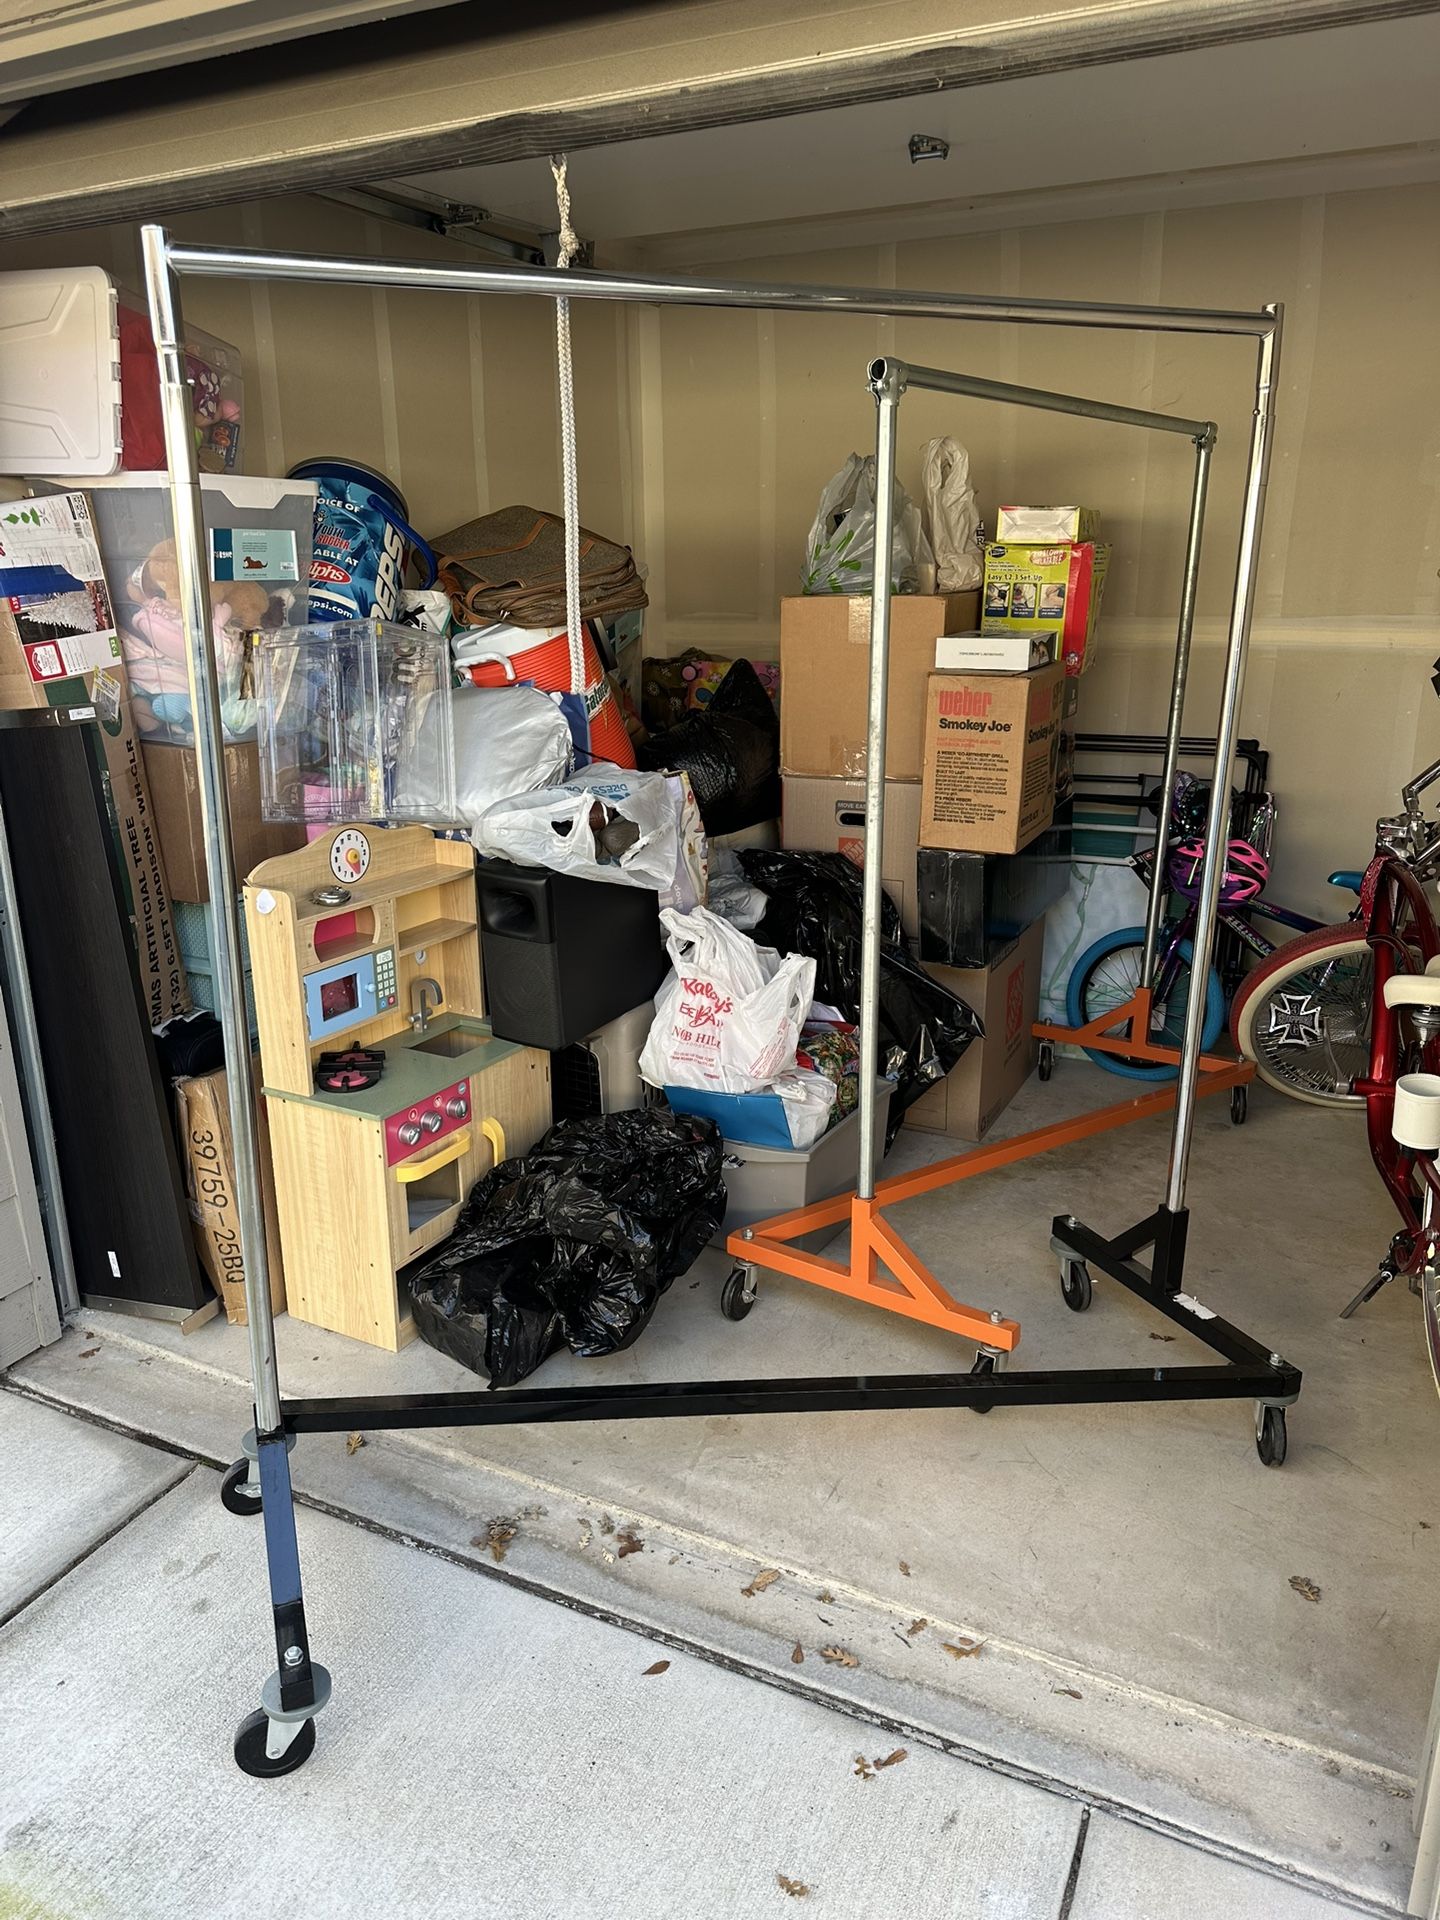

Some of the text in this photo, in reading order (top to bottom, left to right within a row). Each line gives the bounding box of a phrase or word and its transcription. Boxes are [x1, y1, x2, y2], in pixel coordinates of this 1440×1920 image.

[345, 503, 360, 513] OF
[344, 556, 359, 567] AT
[938, 686, 992, 718] weber
[939, 718, 1011, 732] Smokey Joe
[126, 738, 147, 815] WH-CLR
[591, 784, 628, 794] DRESS
[126, 814, 144, 868] TREE
[138, 870, 160, 975] ARTIFICIAL
[161, 918, 176, 966] 6.5FT
